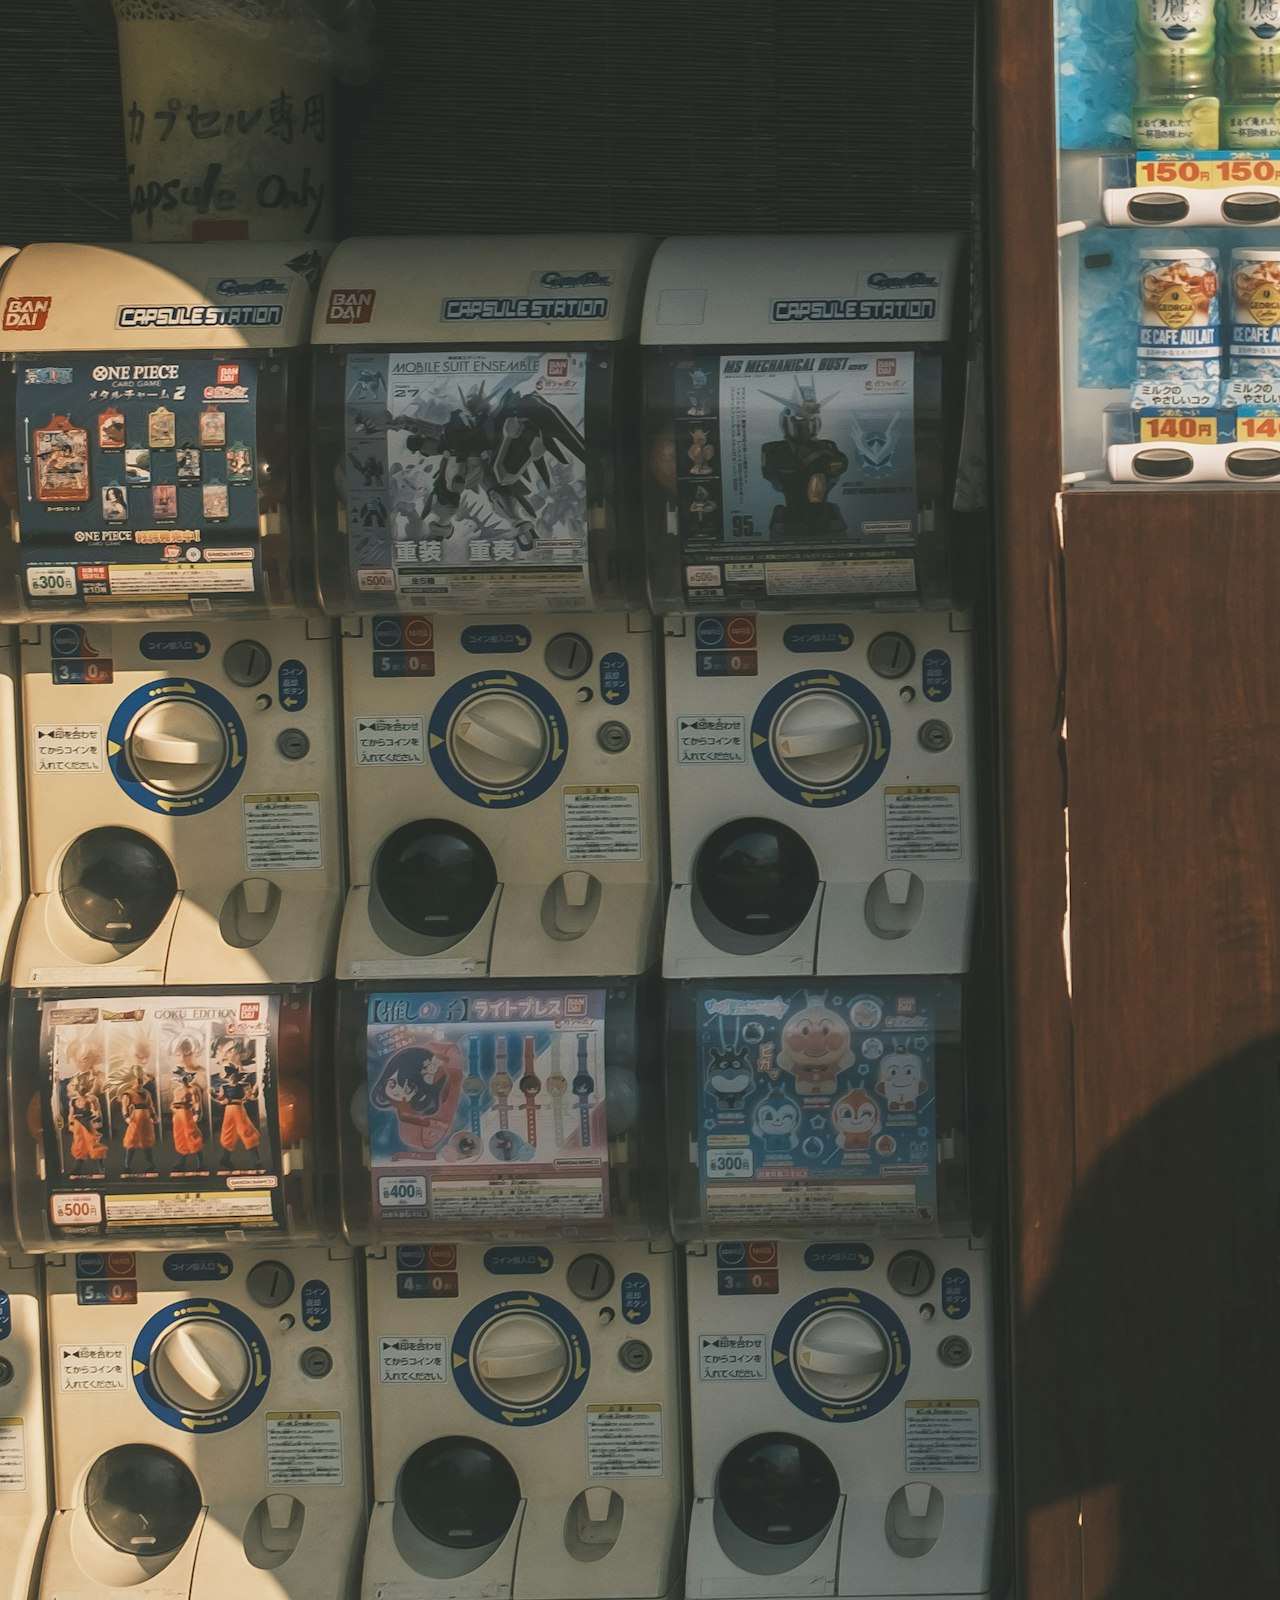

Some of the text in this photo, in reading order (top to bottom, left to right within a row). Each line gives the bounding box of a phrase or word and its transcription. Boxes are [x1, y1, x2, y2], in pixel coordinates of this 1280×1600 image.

[128, 91, 326, 145] カプセル専用
[1141, 161, 1210, 182] 150円
[332, 293, 372, 306] BAN
[329, 305, 362, 320] DAI
[446, 299, 605, 318] CAPSULE STATION
[92, 364, 180, 381] ONE PIECE
[392, 360, 540, 373] MOBILE SUIT ENSEMBLE
[89, 385, 187, 401] メタルチャーム 2
[394, 388, 420, 398] 27
[1141, 386, 1182, 395] ミルクの
[1232, 383, 1273, 394] ミルクの
[1152, 395, 1210, 406] やさしいコク
[395, 539, 515, 562] 重装 重奏
[39, 745, 98, 755] てからコインを
[154, 1008, 236, 1019] GOKU EDITION
